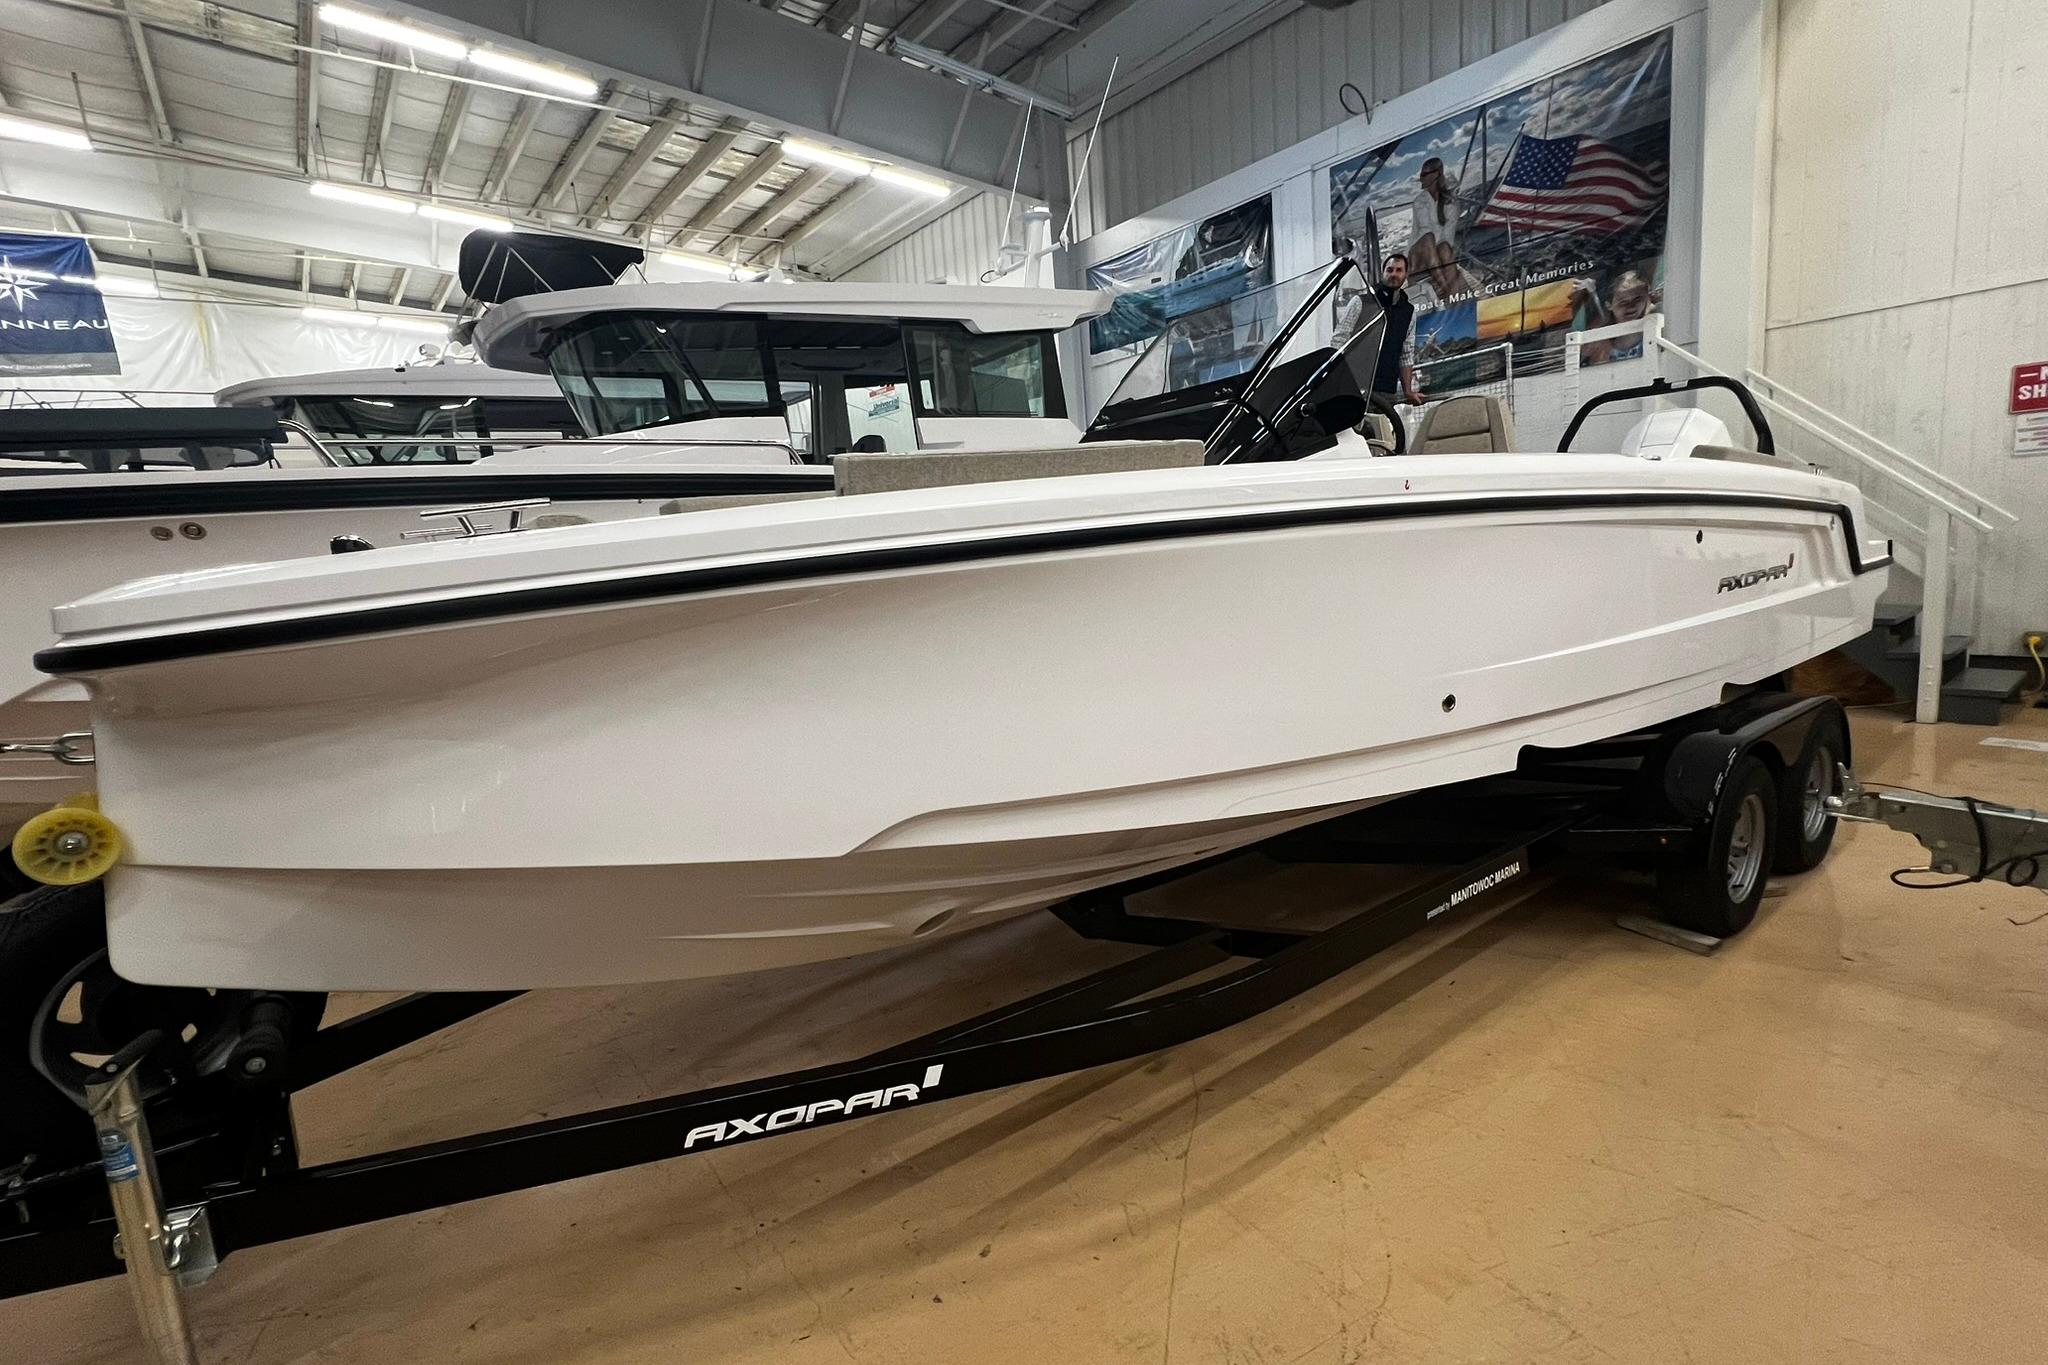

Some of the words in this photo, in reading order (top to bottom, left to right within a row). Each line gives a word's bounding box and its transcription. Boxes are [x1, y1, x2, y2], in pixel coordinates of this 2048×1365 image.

[1414, 299, 1445, 312] Boats
[1449, 288, 1481, 304] Make
[1485, 278, 1521, 294] Great
[1526, 260, 1594, 284] Memories
[0, 319, 109, 330] NNEAU
[1451, 874, 1495, 907] MANITOWOC
[1495, 861, 1521, 884] MARINA
[684, 1082, 921, 1149] AXOPAR
